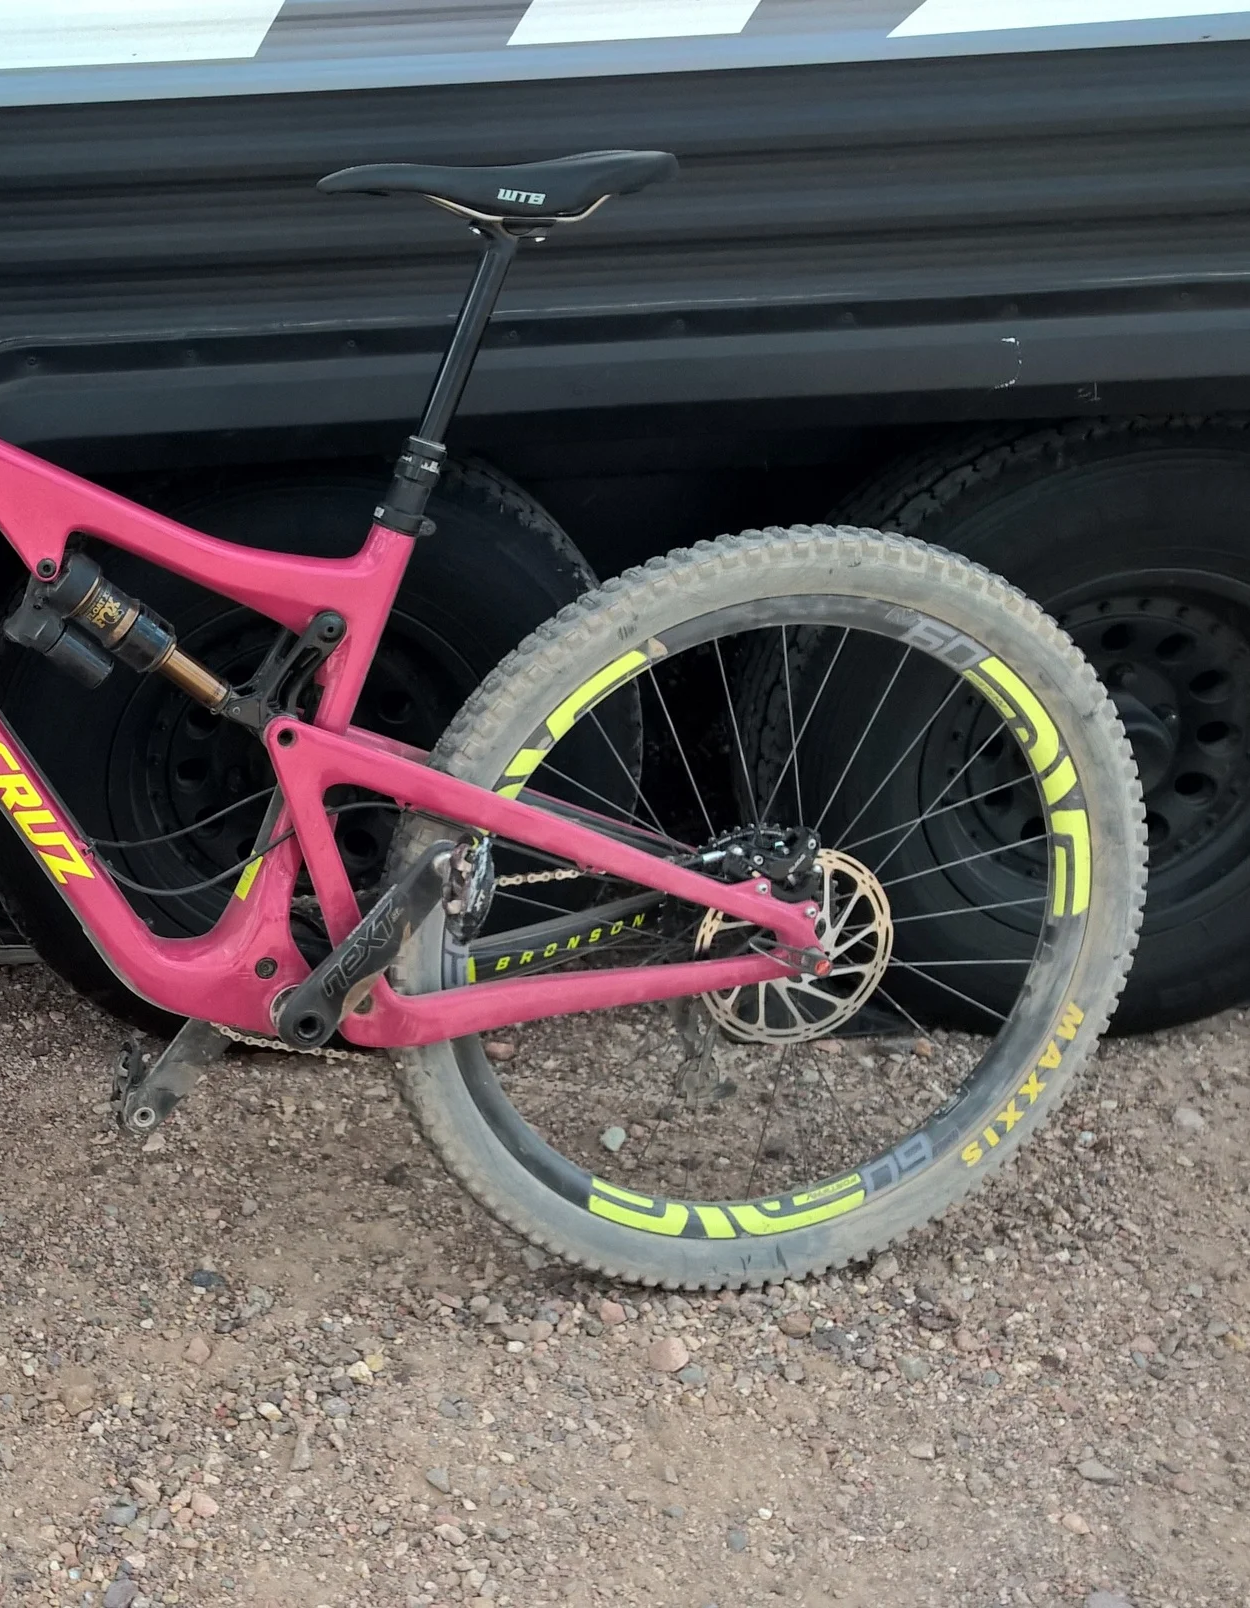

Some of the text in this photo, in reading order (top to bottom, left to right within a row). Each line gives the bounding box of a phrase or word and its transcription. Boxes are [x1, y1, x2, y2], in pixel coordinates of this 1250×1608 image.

[497, 188, 546, 206] WTB
[495, 913, 646, 971] BRONSON
[960, 1002, 1086, 1168] MAXXIS
